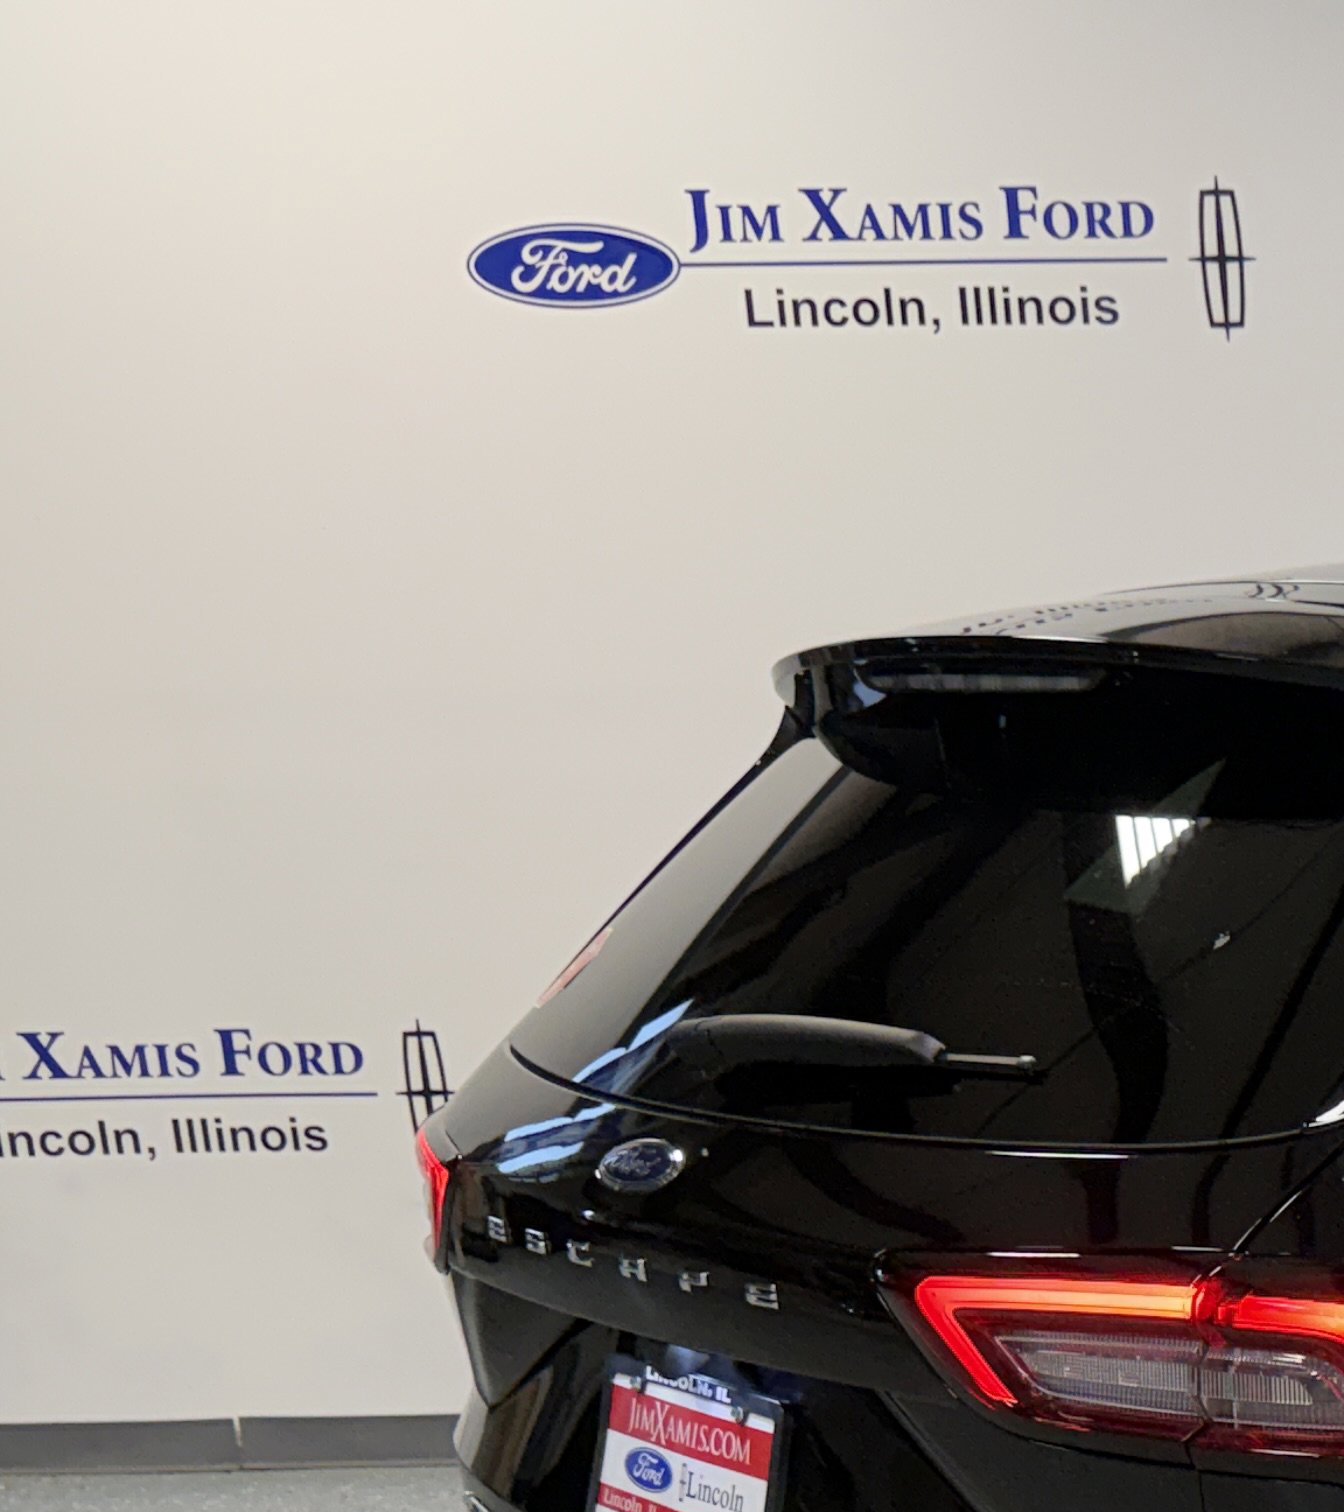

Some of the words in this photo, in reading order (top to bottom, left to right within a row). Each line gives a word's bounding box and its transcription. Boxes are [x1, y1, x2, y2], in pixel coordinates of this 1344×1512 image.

[511, 238, 637, 293] Ford
[744, 287, 941, 335] Lincoln,
[958, 285, 1120, 327] Illinois
[0, 1119, 156, 1161] ncoln,
[171, 1116, 329, 1154] Illinois
[632, 1452, 666, 1486] Ford
